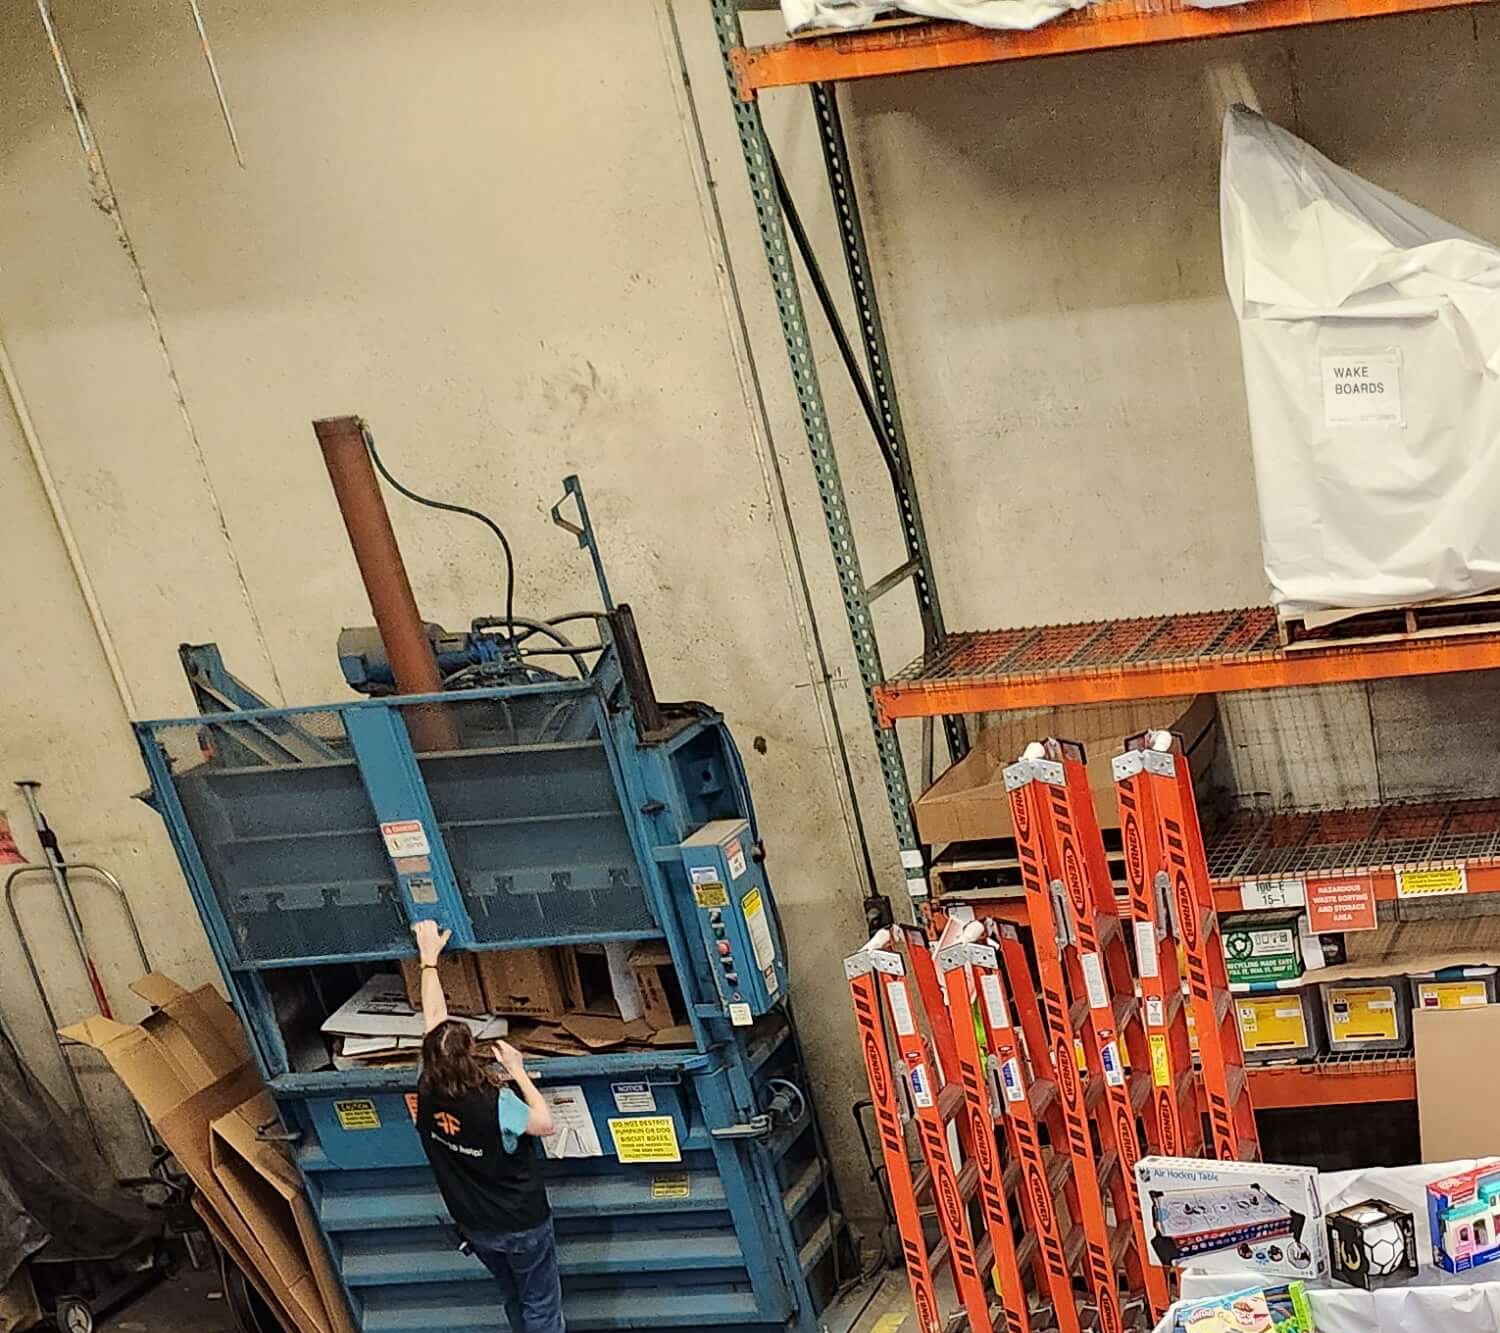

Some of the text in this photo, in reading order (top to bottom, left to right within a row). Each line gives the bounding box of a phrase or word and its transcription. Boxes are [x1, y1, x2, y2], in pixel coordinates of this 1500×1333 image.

[1333, 366, 1369, 378] WAKE
[1335, 382, 1385, 394] BOARDS
[1127, 829, 1142, 881] WERNER
[1067, 853, 1083, 910] WERNER
[1317, 884, 1361, 894] HAZARDOUS
[1262, 894, 1286, 905] 15-1
[1312, 893, 1369, 904] WASTE SORTING
[1179, 886, 1194, 941] WERNER
[1318, 903, 1366, 913] AND STORAGE
[1260, 959, 1276, 968] MADE
[1277, 958, 1293, 966] EASY
[867, 1045, 885, 1091] WERNER
[1059, 1050, 1074, 1098] WERNER
[612, 1119, 670, 1128] DO NOT DESTROY
[1162, 1103, 1175, 1151] WERNER
[620, 1135, 645, 1143] BISCUIT
[973, 1120, 991, 1166] WERNER
[1153, 1168, 1219, 1182] Air Hockey Table
[941, 1178, 960, 1229] WERNER
[1031, 1177, 1050, 1228] WERNER
